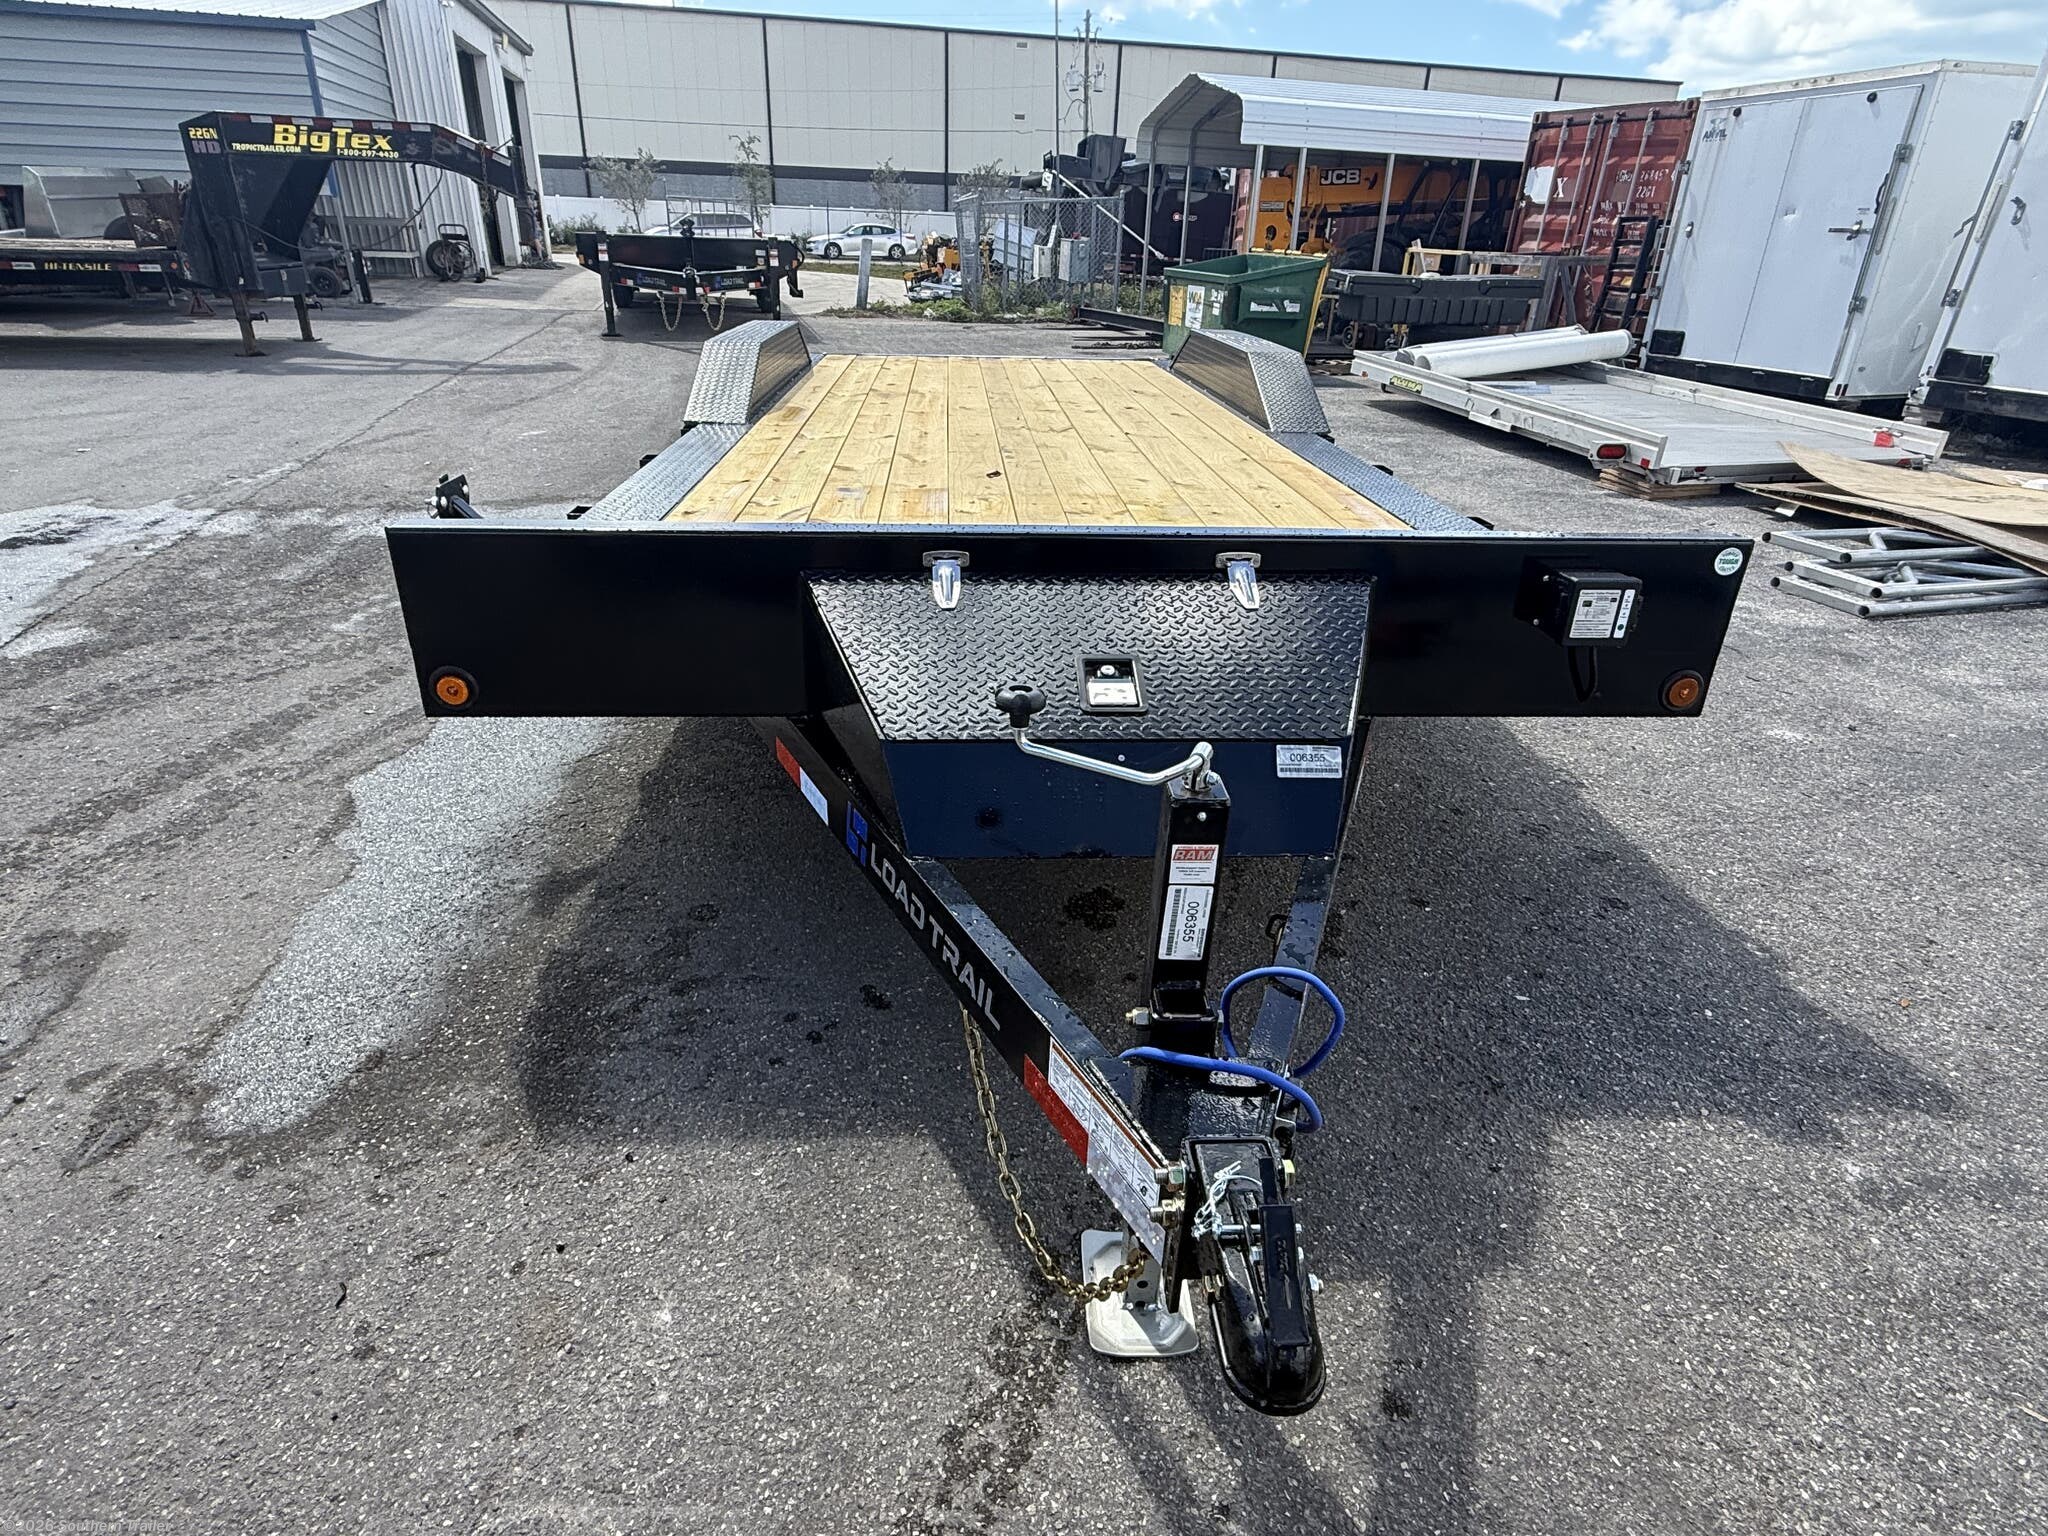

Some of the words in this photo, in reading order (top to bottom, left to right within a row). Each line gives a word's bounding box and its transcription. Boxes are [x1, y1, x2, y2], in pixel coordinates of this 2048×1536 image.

[191, 140, 221, 154] HD
[231, 142, 302, 153] TROPICTRAILER.COM
[1321, 169, 1360, 185] JCB
[43, 261, 113, 271] HI-TENSILE
[1390, 377, 1422, 393] ALUMA
[1290, 753, 1326, 763] 006355
[1174, 850, 1213, 861] RAM
[1182, 901, 1200, 943] 006355
[870, 842, 926, 931] LOAD
[928, 914, 1001, 1032] TRAIL
